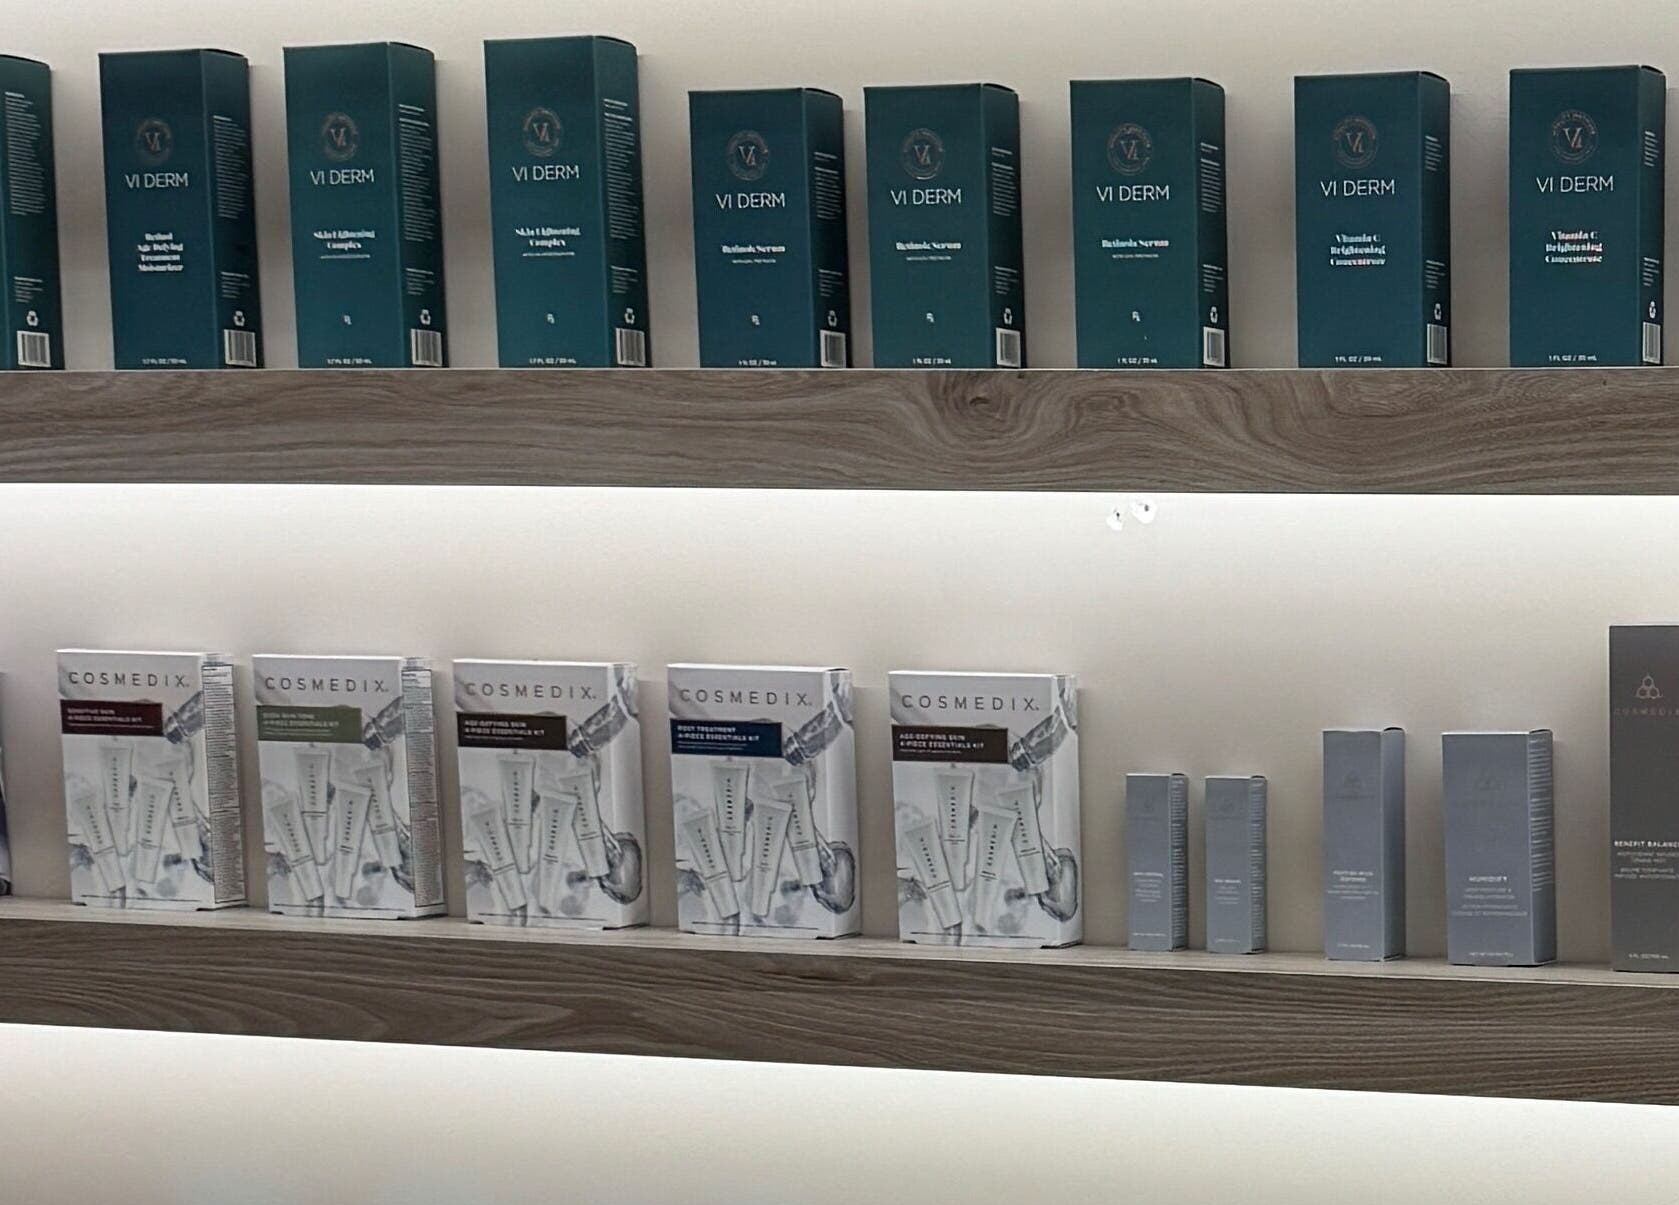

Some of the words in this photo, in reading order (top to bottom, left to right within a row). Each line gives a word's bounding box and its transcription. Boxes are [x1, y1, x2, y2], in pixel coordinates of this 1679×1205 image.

[125, 173, 140, 189] VI
[144, 172, 189, 188] DERM
[310, 170, 326, 185] VI
[329, 168, 375, 184] DERM
[512, 166, 529, 181] VI
[532, 164, 580, 180] DERM
[1320, 180, 1338, 197] VI
[1343, 179, 1396, 196] DERM
[1536, 176, 1554, 193] VI
[1559, 175, 1615, 192] DERM
[715, 194, 732, 209] VI
[737, 192, 786, 209] DERM
[890, 189, 907, 205] VI
[912, 188, 962, 205] DERM
[1096, 186, 1113, 202] VI
[1119, 184, 1170, 201] DERM
[68, 670, 186, 688] COSMEDIX
[265, 676, 385, 693] COSMEDIX
[465, 682, 593, 700] COSMEDIX
[679, 688, 809, 706] COSMEDIX
[901, 694, 1035, 712] COSMEDIX
[1614, 840, 1646, 848] BENEFIT
